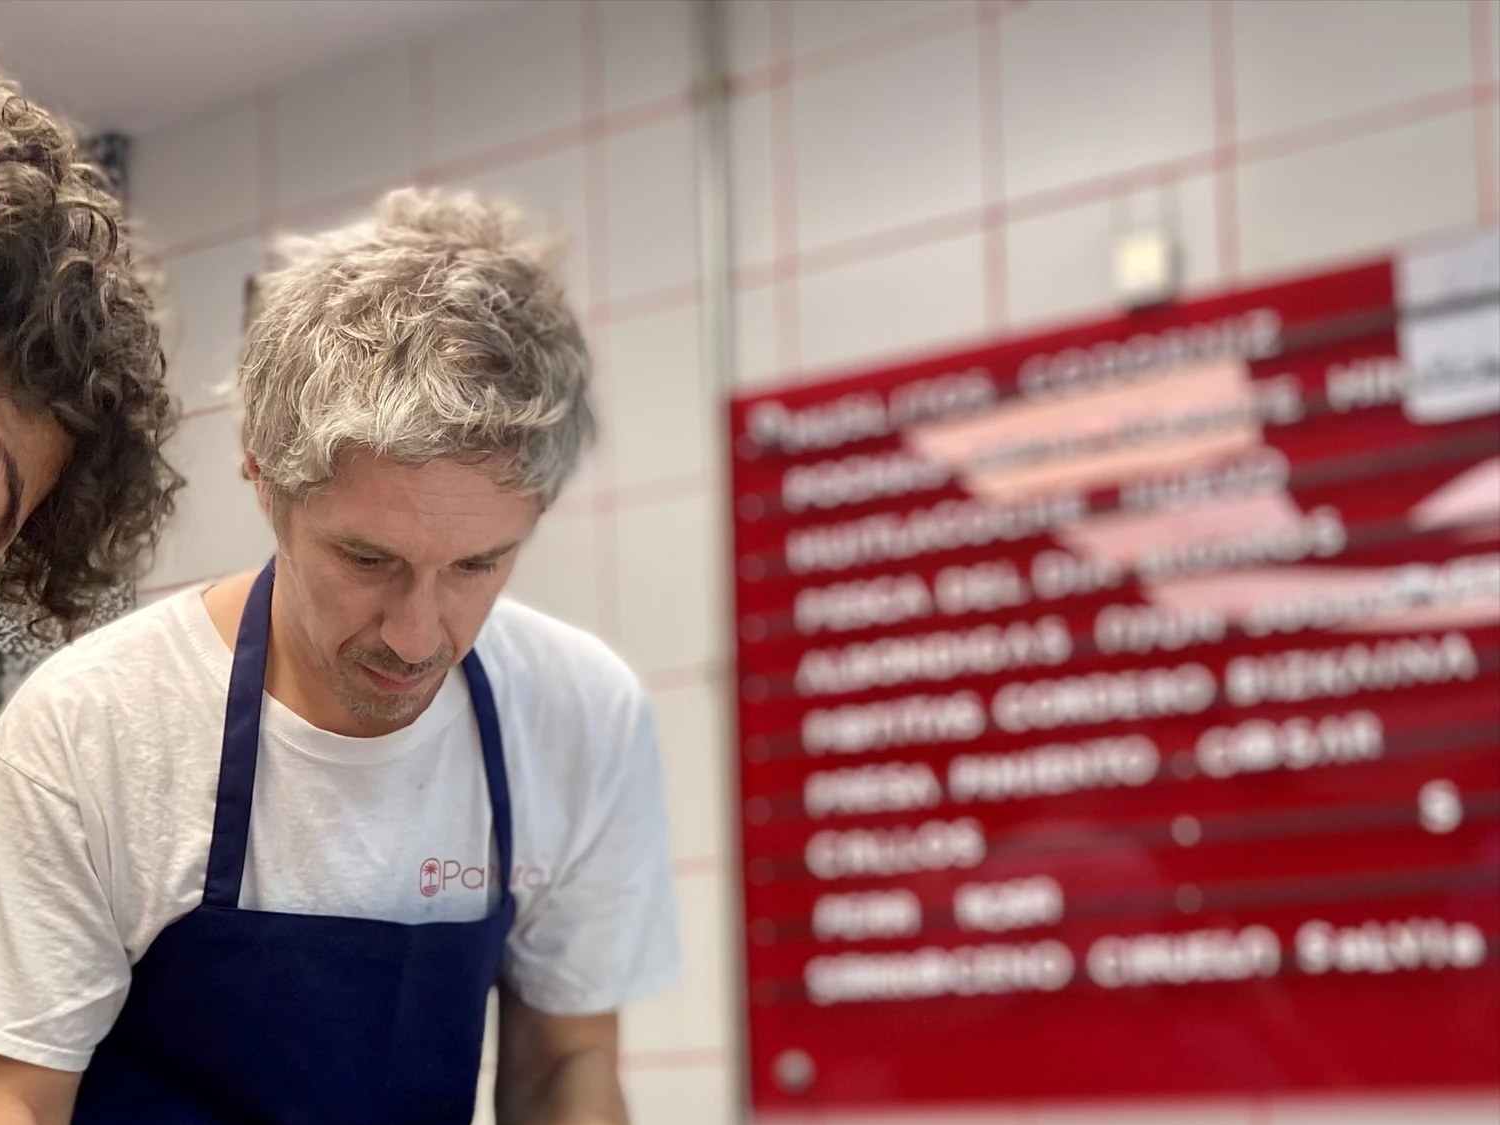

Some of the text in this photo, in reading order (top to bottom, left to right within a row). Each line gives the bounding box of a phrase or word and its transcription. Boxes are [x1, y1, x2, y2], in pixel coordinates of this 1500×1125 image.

[937, 562, 1023, 612] DEL
[995, 665, 1214, 730] CORDERO
[1228, 634, 1475, 703] BIZKAINA
[808, 820, 984, 876] CALLOS
